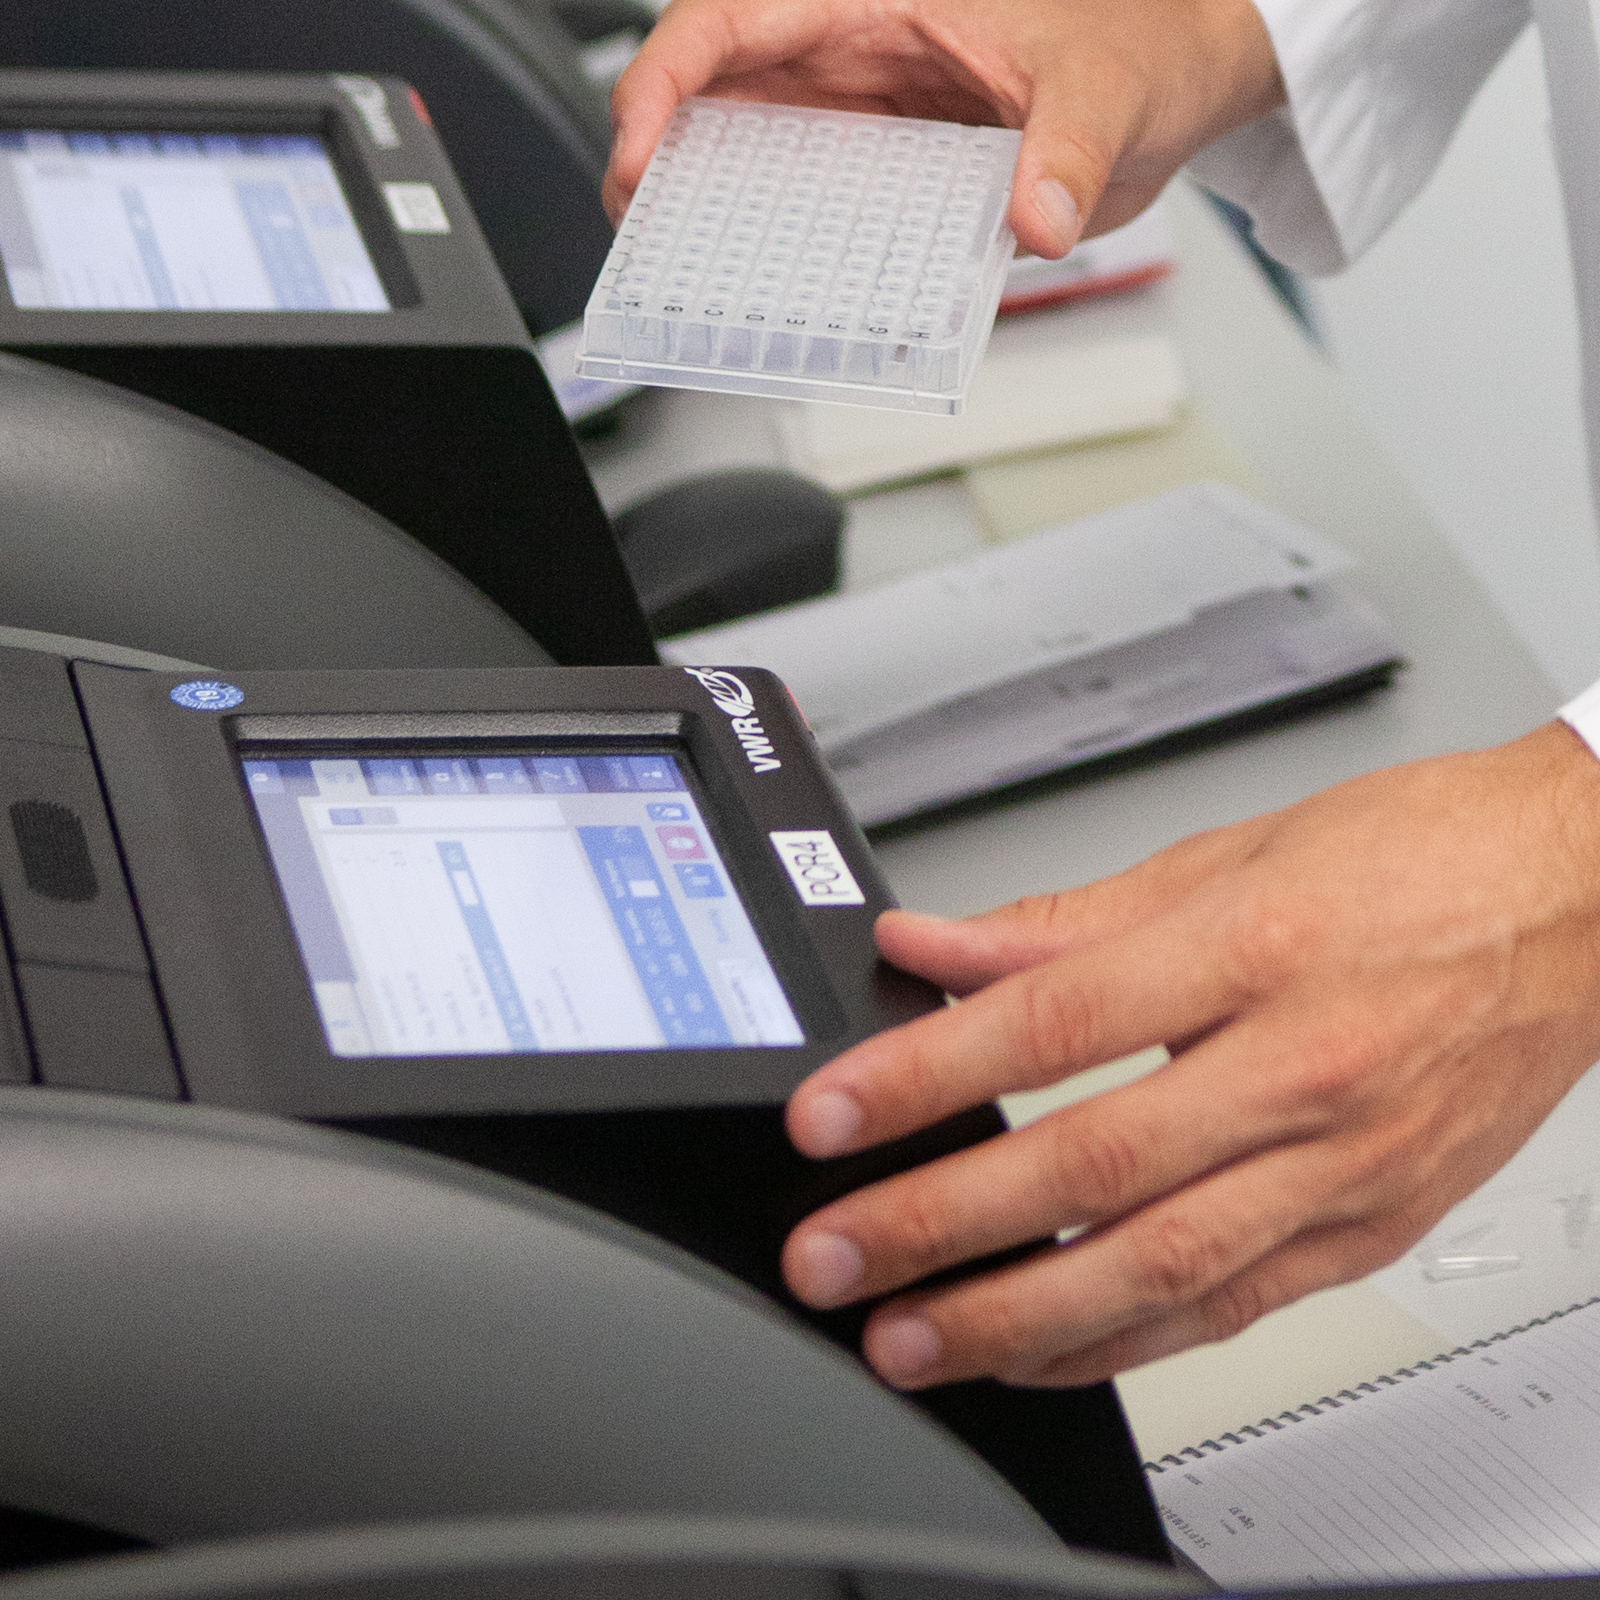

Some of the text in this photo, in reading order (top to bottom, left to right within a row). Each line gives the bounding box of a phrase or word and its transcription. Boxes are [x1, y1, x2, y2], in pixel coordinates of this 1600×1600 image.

[663, 305, 684, 313] B
[704, 309, 724, 317] C
[746, 313, 765, 321] D
[786, 318, 806, 326] E
[869, 326, 889, 334] G
[910, 331, 930, 339] H
[730, 717, 782, 774] VWR
[786, 840, 851, 896] PCR4
